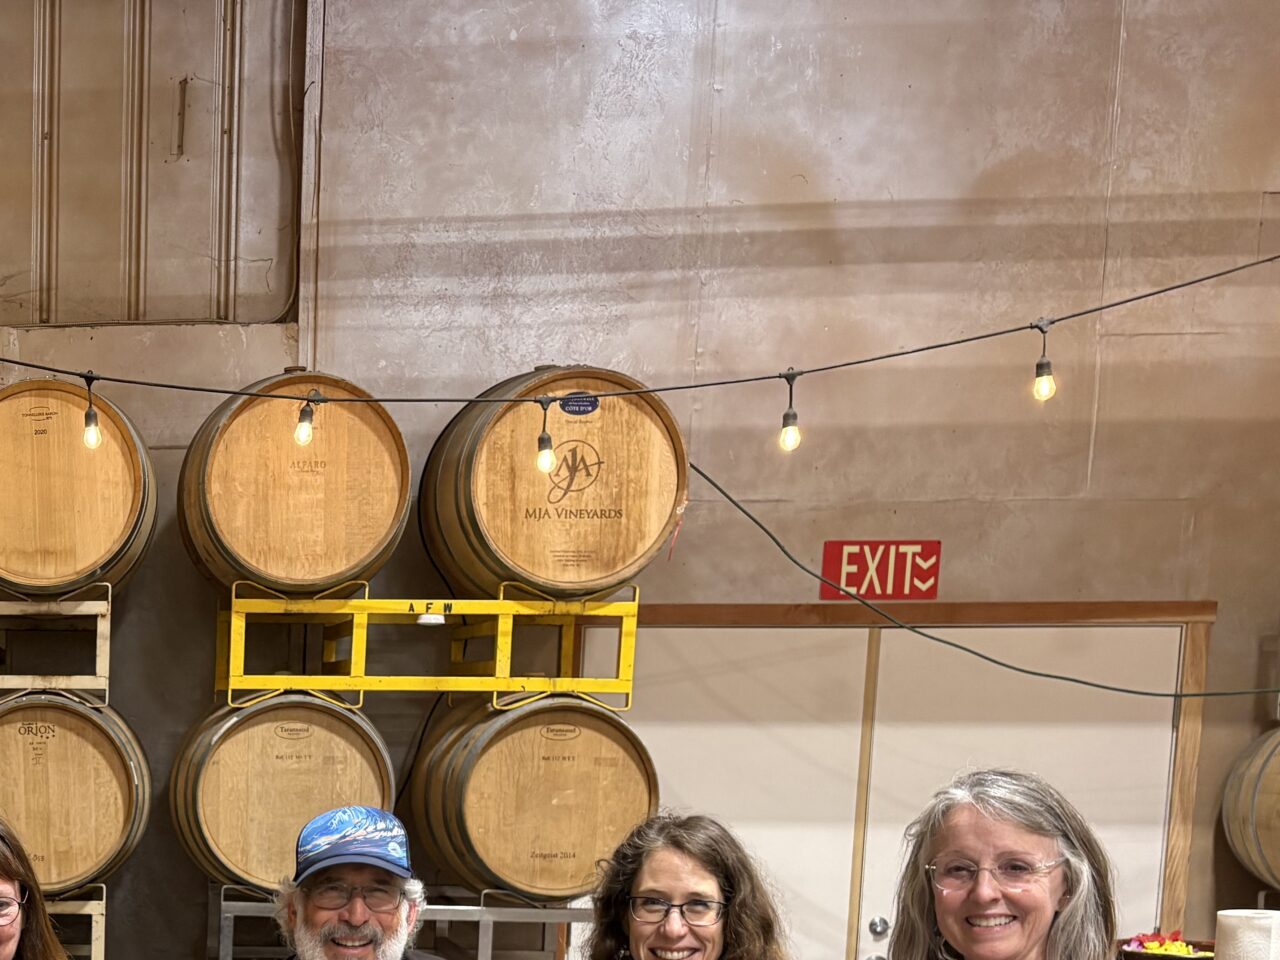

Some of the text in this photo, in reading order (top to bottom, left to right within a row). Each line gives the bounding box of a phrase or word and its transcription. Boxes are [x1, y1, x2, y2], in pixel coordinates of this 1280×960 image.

[289, 460, 327, 469] ALFARO
[524, 508, 624, 521] MJA VINEYARDS
[839, 544, 922, 596] EXIT
[18, 723, 56, 737] ORION
[559, 851, 576, 859] 2014
